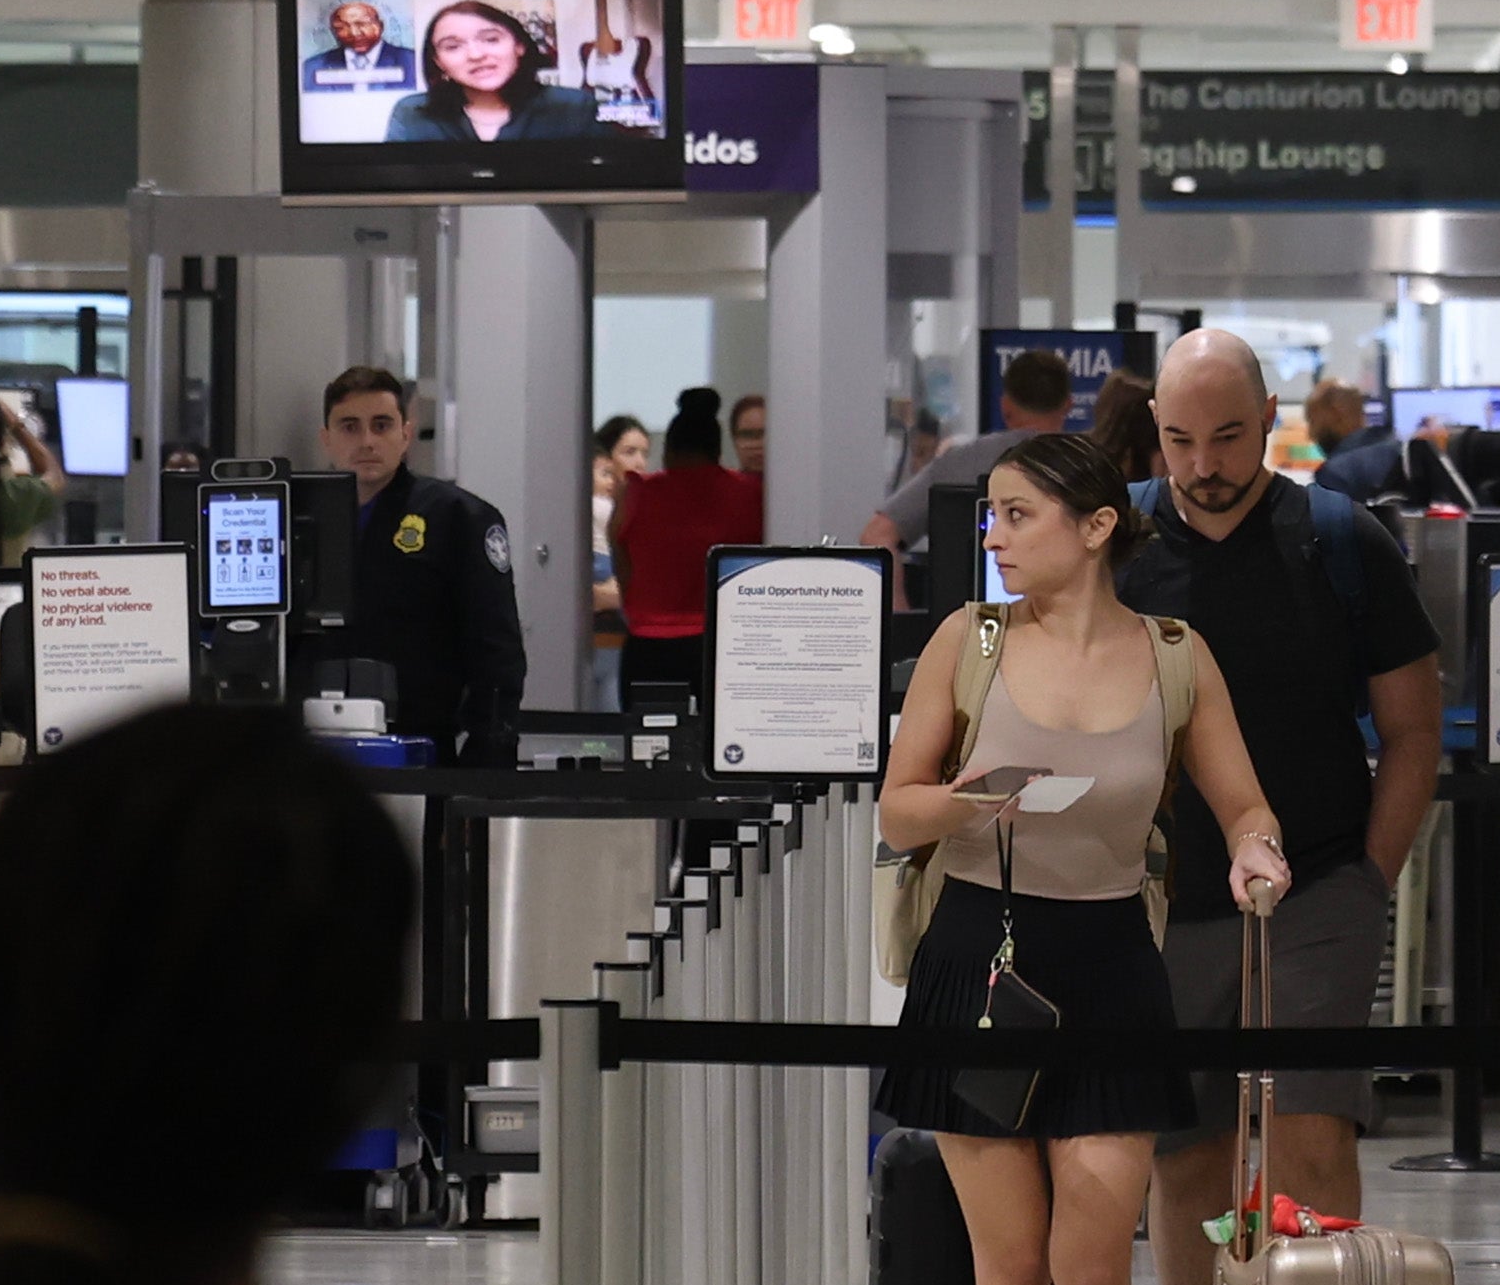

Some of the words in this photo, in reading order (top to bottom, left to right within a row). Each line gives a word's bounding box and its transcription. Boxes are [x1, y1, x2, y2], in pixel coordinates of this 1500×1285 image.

[1200, 79, 1366, 111] Centurion
[684, 131, 759, 165] idos
[1257, 140, 1385, 176] Lounge
[41, 571, 56, 581] No
[59, 570, 100, 581] threats.
[41, 588, 57, 598] No
[60, 587, 95, 597] verbal
[97, 586, 132, 596] abuse.
[738, 585, 766, 597] Equal
[768, 585, 829, 598] Opportunity
[831, 586, 864, 597] Notice
[42, 604, 57, 614] No
[60, 602, 104, 615] physical
[107, 602, 153, 612] violence
[42, 617, 53, 627] of
[56, 617, 77, 628] any
[79, 615, 107, 626] kind.
